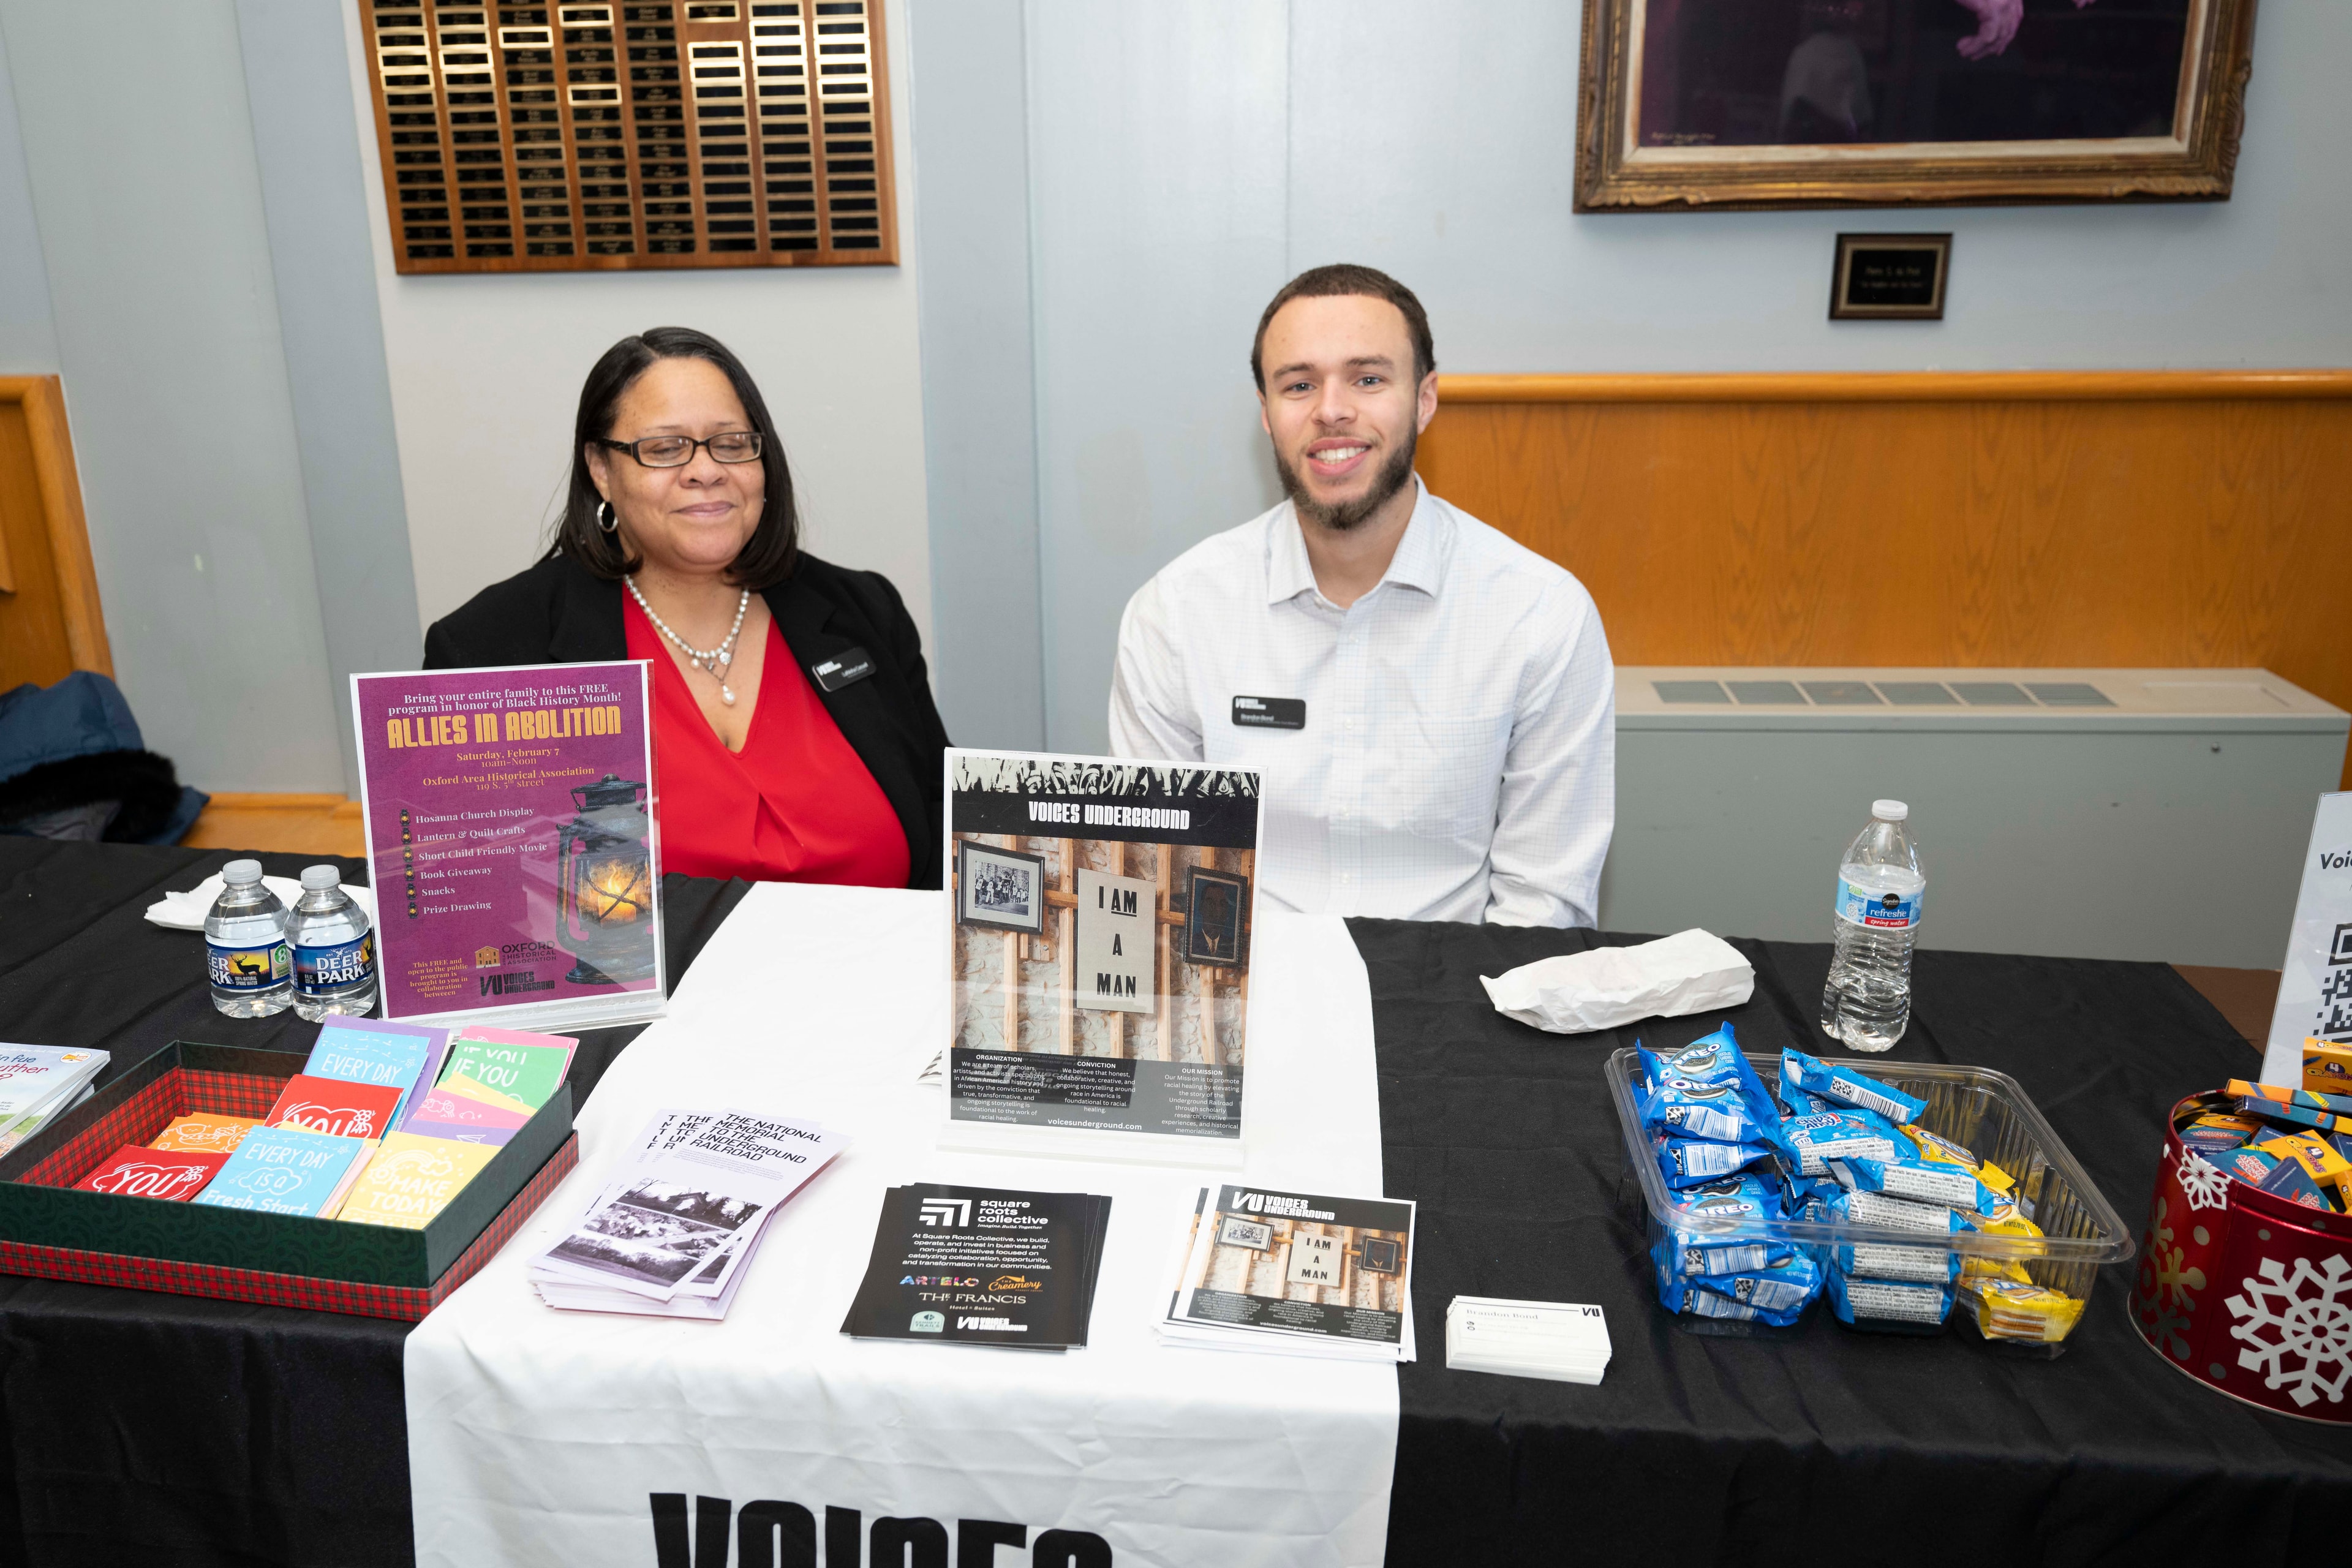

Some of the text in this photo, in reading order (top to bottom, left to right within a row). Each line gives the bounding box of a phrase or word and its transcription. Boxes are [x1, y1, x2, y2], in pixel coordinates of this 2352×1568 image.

[404, 693, 436, 704] Bring
[439, 693, 465, 703] your
[469, 690, 502, 699] entire
[505, 688, 539, 698] family
[556, 685, 576, 695] this
[579, 684, 608, 693] FREE
[388, 692, 621, 716] program in honor of Black History Month!
[387, 706, 621, 748] ALLIES IN ABOLITION
[457, 750, 504, 761] Saturday,
[508, 748, 552, 758] February
[423, 775, 459, 786] Oxford
[488, 770, 536, 781] Historical
[539, 767, 594, 778] Association
[517, 778, 545, 788] street
[416, 807, 535, 823] Hosanna Church Display
[1029, 801, 1190, 830] VOICES UNDERGROUND
[417, 832, 455, 842] Lantern
[470, 829, 494, 839] Quilt
[497, 826, 526, 835] Crafts
[419, 843, 547, 861] Short Child Friendly Movie
[2321, 850, 2352, 870] Voi
[421, 868, 492, 880] Book Giveaway
[422, 887, 455, 896] Snacks
[424, 902, 491, 914] Prize Drawing
[1099, 886, 1137, 917] I AM
[502, 941, 555, 953] OXFORD
[1112, 933, 1122, 956] A
[315, 950, 363, 970] DEER
[508, 950, 556, 959] HISTORICAL
[508, 956, 556, 965] ASSOCIATION
[317, 963, 364, 984] PARK
[503, 971, 535, 984] VOICES
[505, 981, 555, 994] UNDERGROUND
[1097, 973, 1136, 998] MAN
[11, 1054, 36, 1063] fue
[321, 1053, 402, 1084] EVERY DAY
[452, 1058, 518, 1087] IF YOU
[2307, 1068, 2352, 1081] CRAYON
[2329, 1063, 2339, 1072] 4
[715, 1120, 785, 1142] MEMORIAL
[726, 1114, 821, 1143] THE NATIONAL
[1048, 1118, 1142, 1130] voicesunderground.com
[709, 1126, 761, 1143] TO THE
[245, 1143, 333, 1169] EVERY DAY
[690, 1140, 763, 1161] RAILROAD
[699, 1133, 807, 1164] UNDERGROUND
[2286, 1137, 2327, 1173] CRAYONS
[111, 1169, 184, 1196] YOU
[254, 1172, 287, 1188] is a
[388, 1176, 453, 1197] MAKE
[202, 1189, 309, 1216] Fresh Start
[369, 1192, 442, 1215] TODAY
[1265, 1196, 1308, 1209] VOICES
[978, 1215, 1048, 1224] collective
[1264, 1205, 1335, 1220] UNDERGROUND
[1314, 1239, 1331, 1250] AM
[1302, 1269, 1327, 1280] MAN
[989, 1280, 1042, 1292] Creamery
[956, 1294, 1026, 1304] FRANCIS
